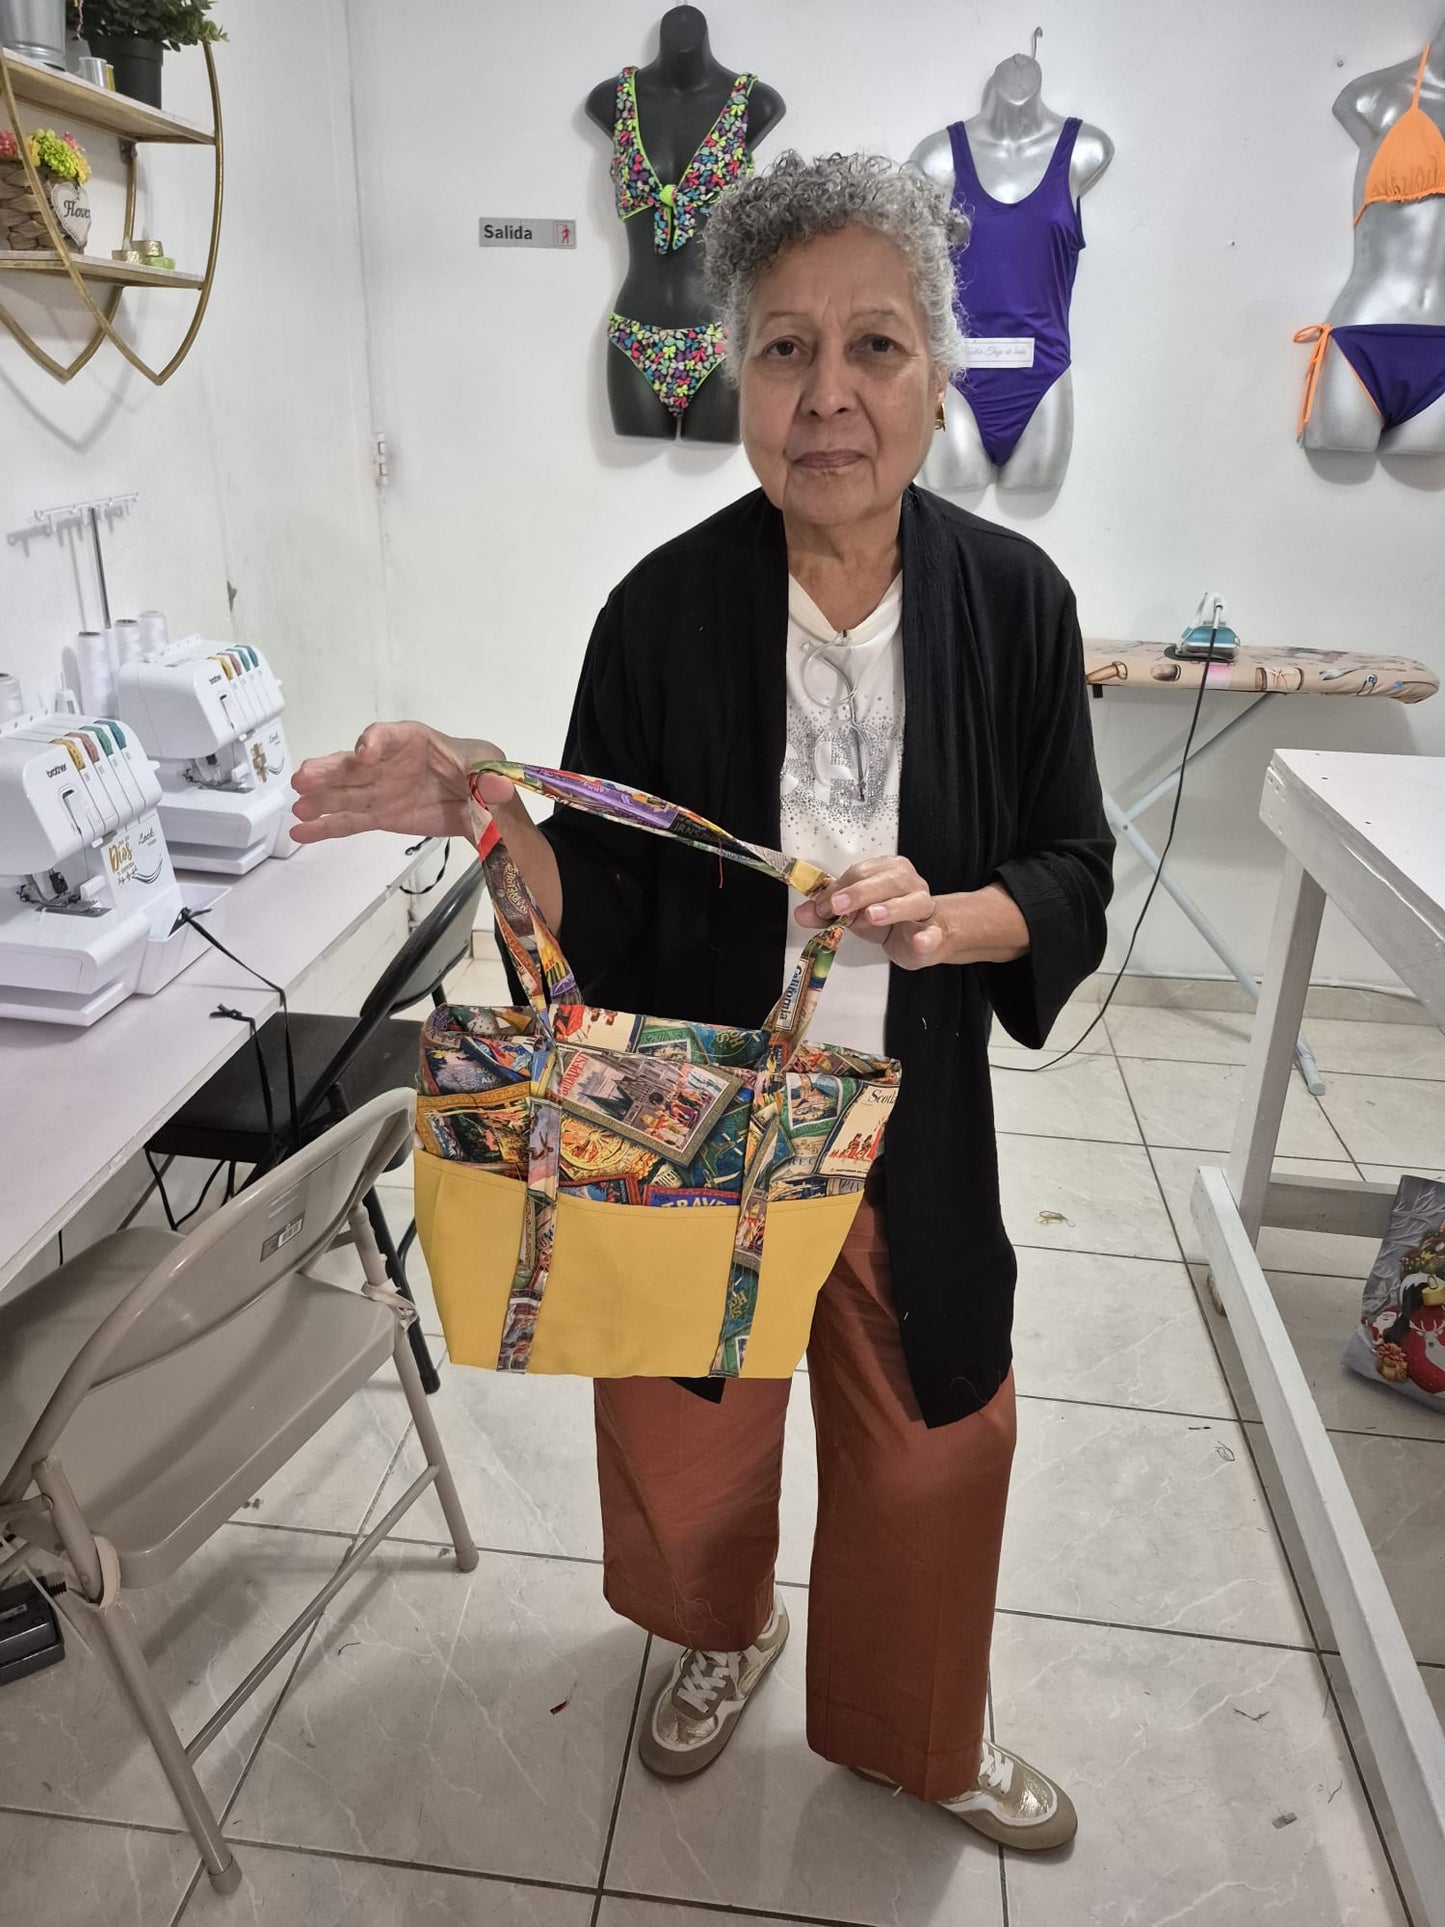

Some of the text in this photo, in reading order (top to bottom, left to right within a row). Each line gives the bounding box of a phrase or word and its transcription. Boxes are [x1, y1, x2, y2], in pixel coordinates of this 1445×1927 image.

[484, 224, 532, 240] Salida
[108, 842, 133, 873] Dios
[779, 964, 803, 1021] California
